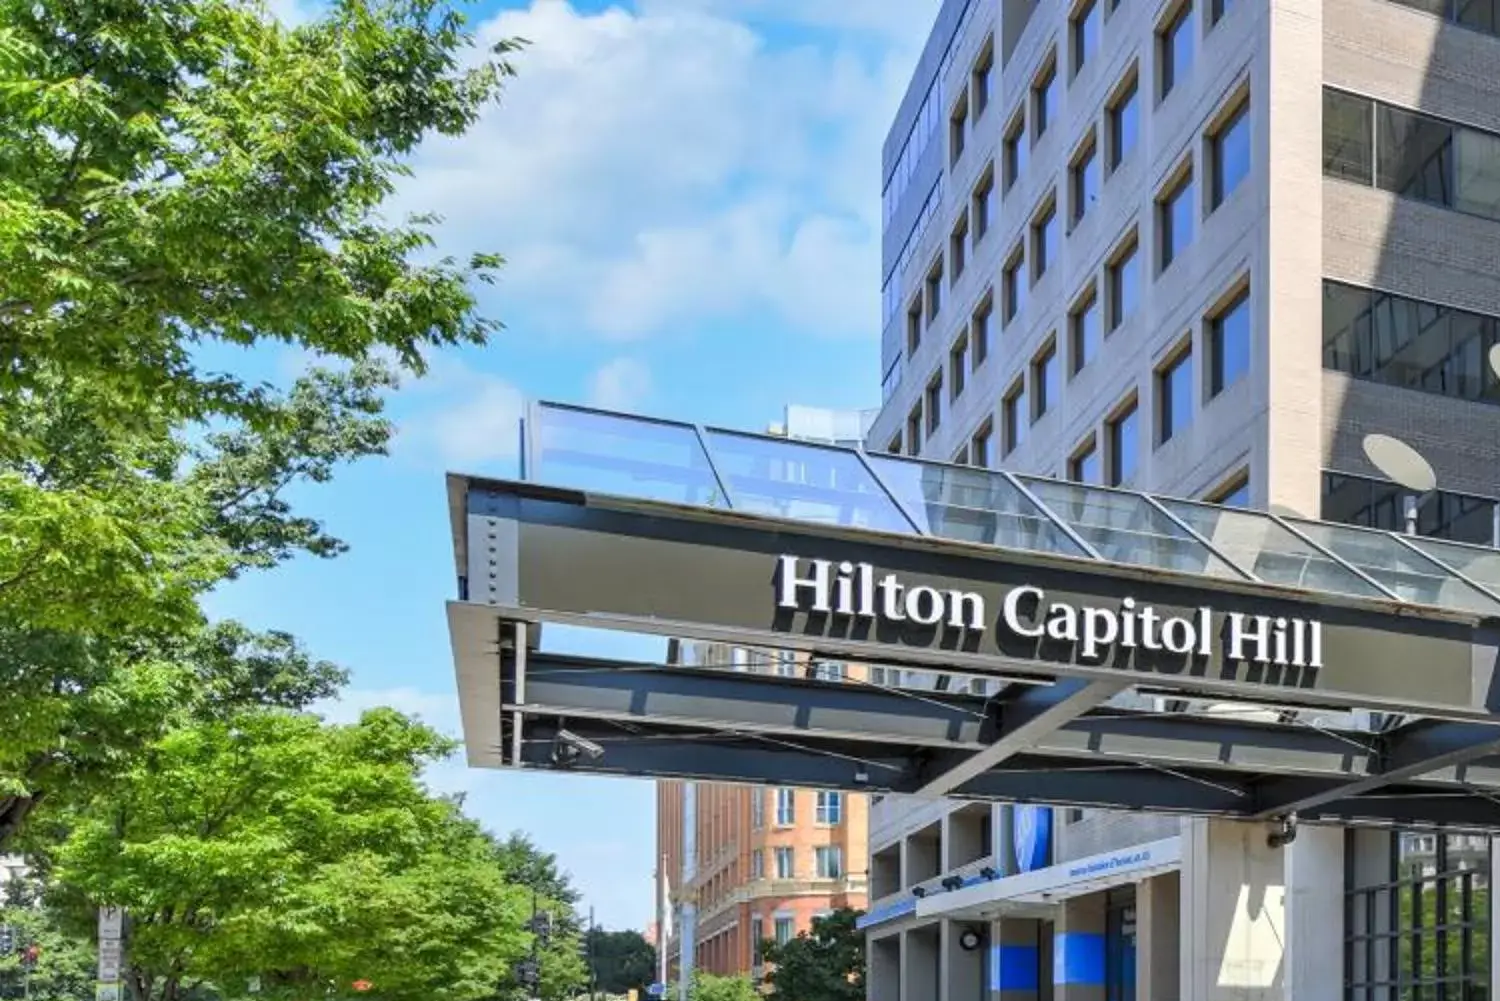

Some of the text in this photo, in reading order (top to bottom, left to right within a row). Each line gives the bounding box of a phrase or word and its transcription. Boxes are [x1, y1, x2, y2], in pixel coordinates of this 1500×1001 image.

[776, 553, 1324, 668] Hilton Capitol Hill
